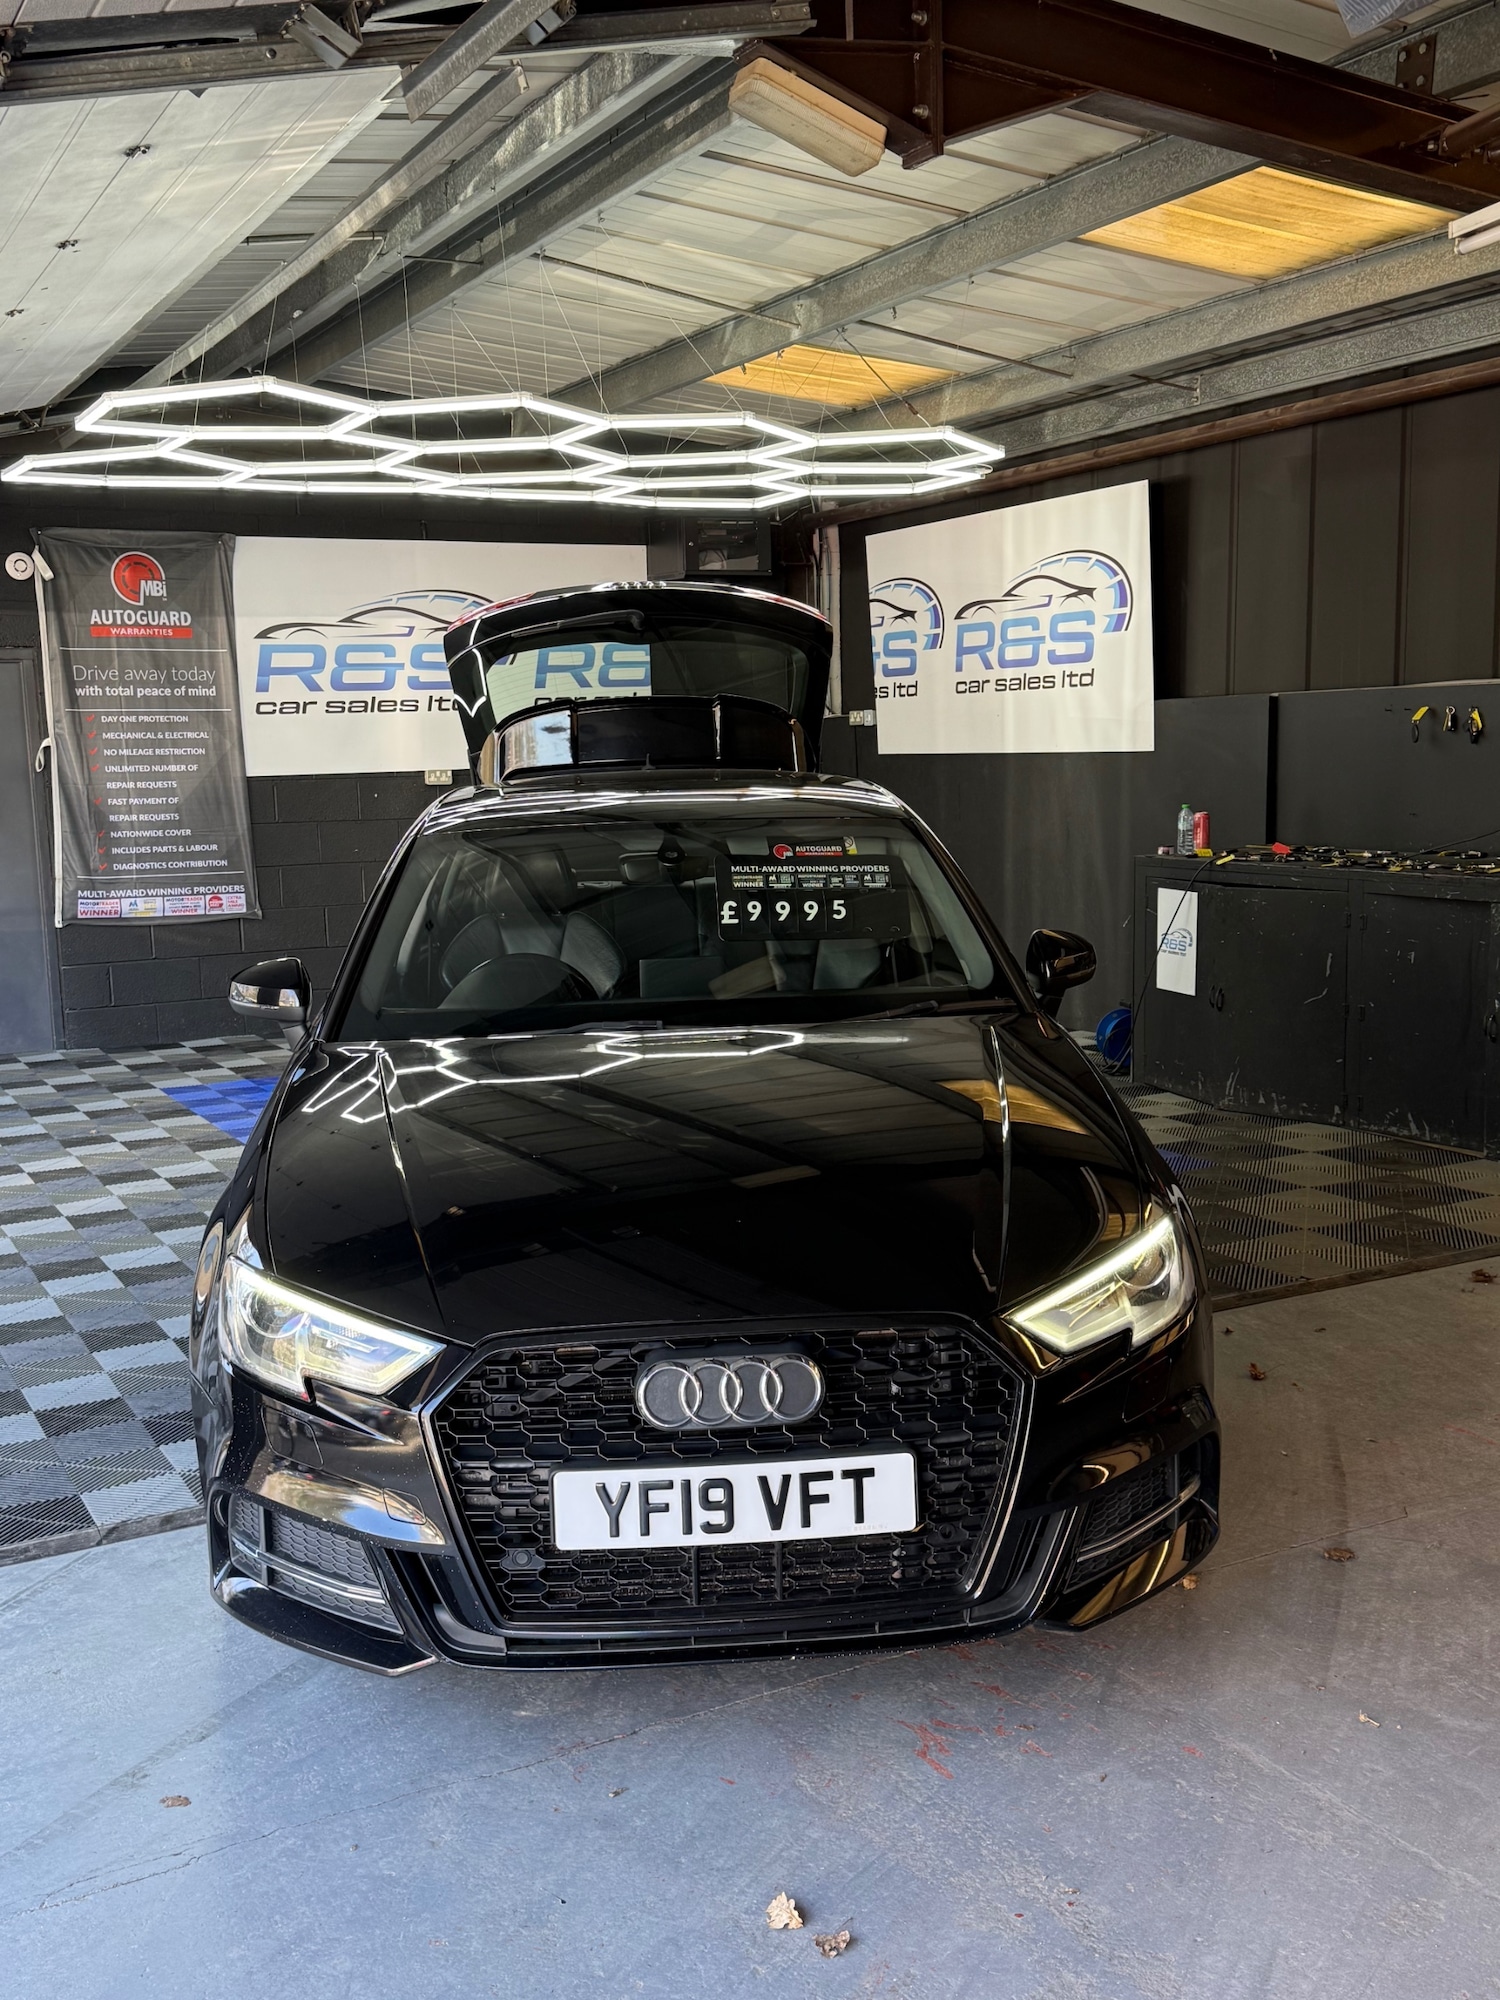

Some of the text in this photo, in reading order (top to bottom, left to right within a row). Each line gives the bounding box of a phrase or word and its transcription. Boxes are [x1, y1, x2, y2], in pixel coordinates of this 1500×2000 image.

[140, 580, 167, 597] MBi
[90, 609, 192, 626] AUTOGUARD
[110, 627, 174, 636] WARRANTIES
[954, 610, 1096, 673] R&S
[255, 643, 453, 693] R&S
[72, 665, 216, 685] Drive away today
[955, 668, 1095, 695] car sales ltd
[74, 684, 217, 699] with total peace of mind
[893, 680, 918, 698] ltd
[255, 699, 317, 716] car
[324, 695, 420, 714] sales
[101, 715, 189, 723] DAY ONE PROTECTION
[102, 731, 210, 740] MECHANICAL & ELECTRICAL
[103, 748, 206, 756] NO MILEAGE RESTRICTION
[105, 764, 199, 773] UNLIMITED NUMBER OF
[106, 781, 177, 789] REPAIR REQUESTS
[107, 797, 180, 805] FAST PAYMENT OF
[109, 813, 180, 822] REPAIR REQUESTS
[110, 829, 192, 838] NATIONWIDE COVER
[111, 846, 151, 855] INCLUDES
[152, 845, 178, 853] PARTS
[185, 844, 219, 852] LABOUR
[113, 859, 228, 871] DIAGNOSTICS CONTRIBUTION
[731, 865, 890, 873] MULTI-AWARD WINNING PROVIDERS
[77, 885, 245, 898] MULTI-AWARD WINNING PROVIDERS
[594, 1467, 876, 1539] YF19 VFT
